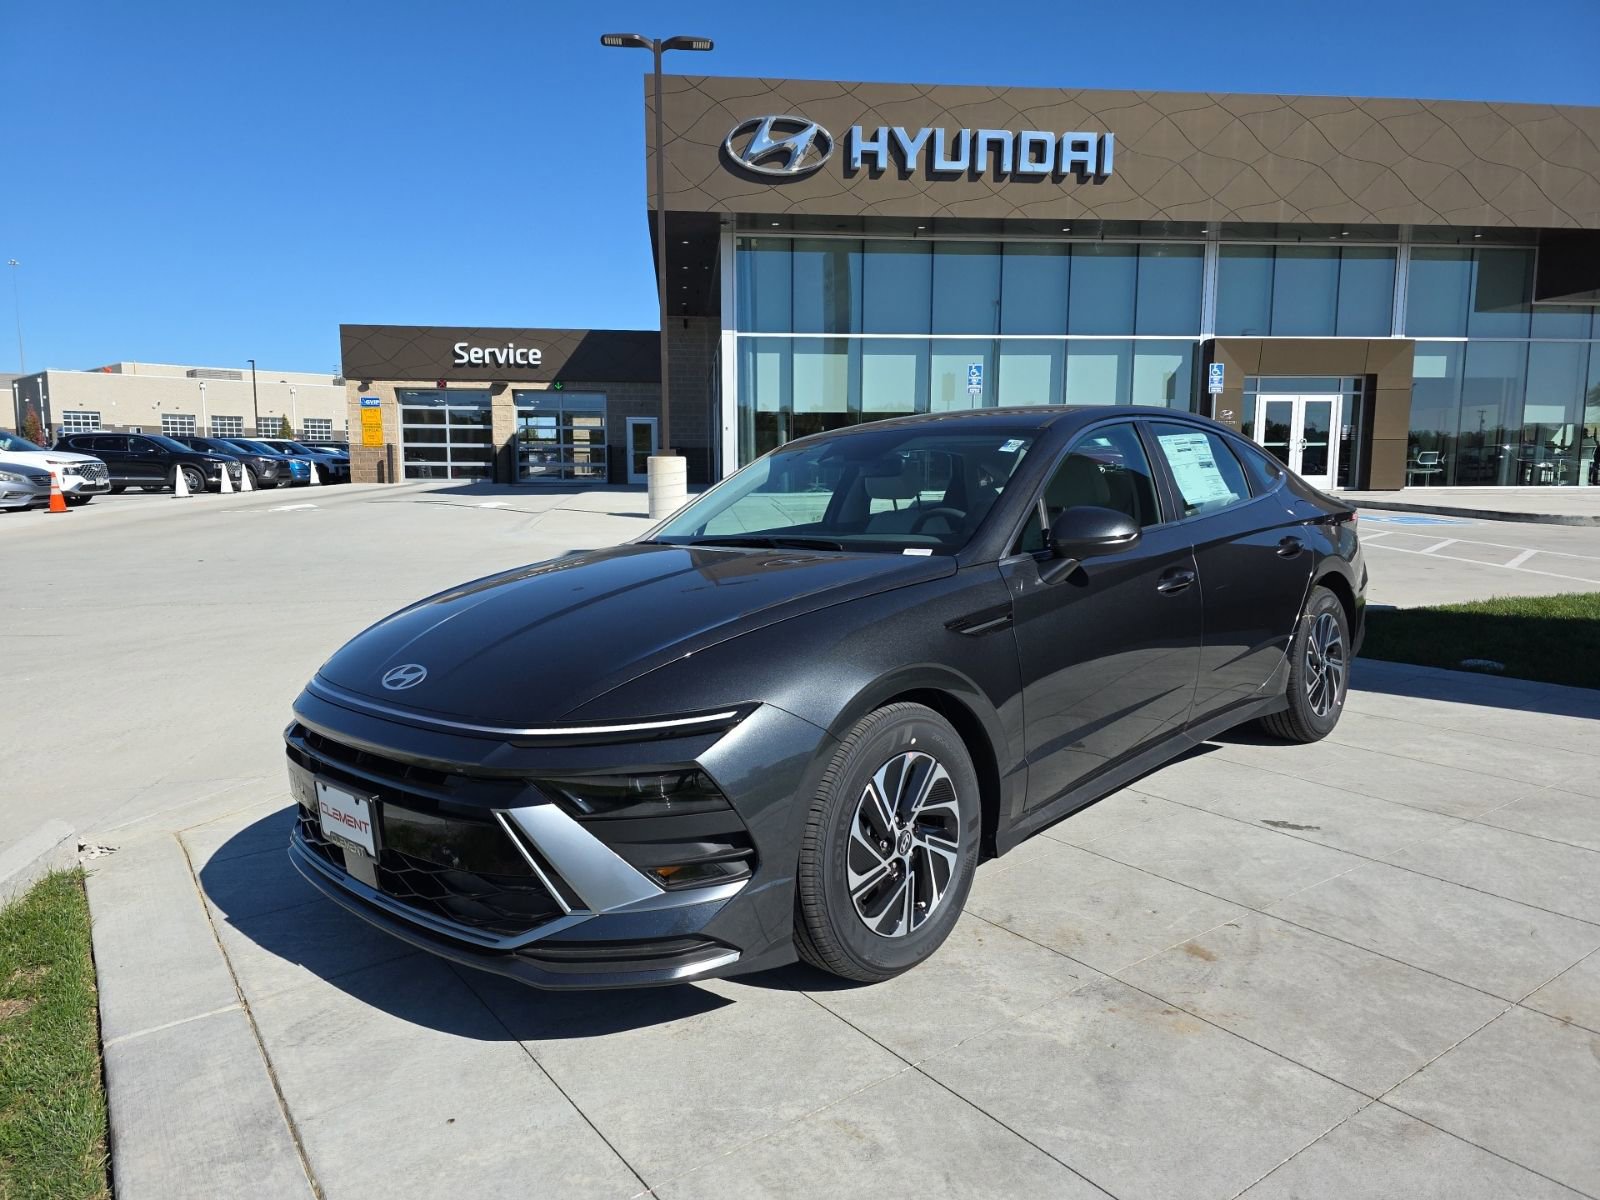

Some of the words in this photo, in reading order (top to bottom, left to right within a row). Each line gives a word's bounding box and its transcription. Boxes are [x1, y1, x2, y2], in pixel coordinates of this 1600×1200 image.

[850, 125, 1115, 177] HYUNDAI
[454, 342, 542, 365] Service
[320, 802, 369, 834] CLEMENT
